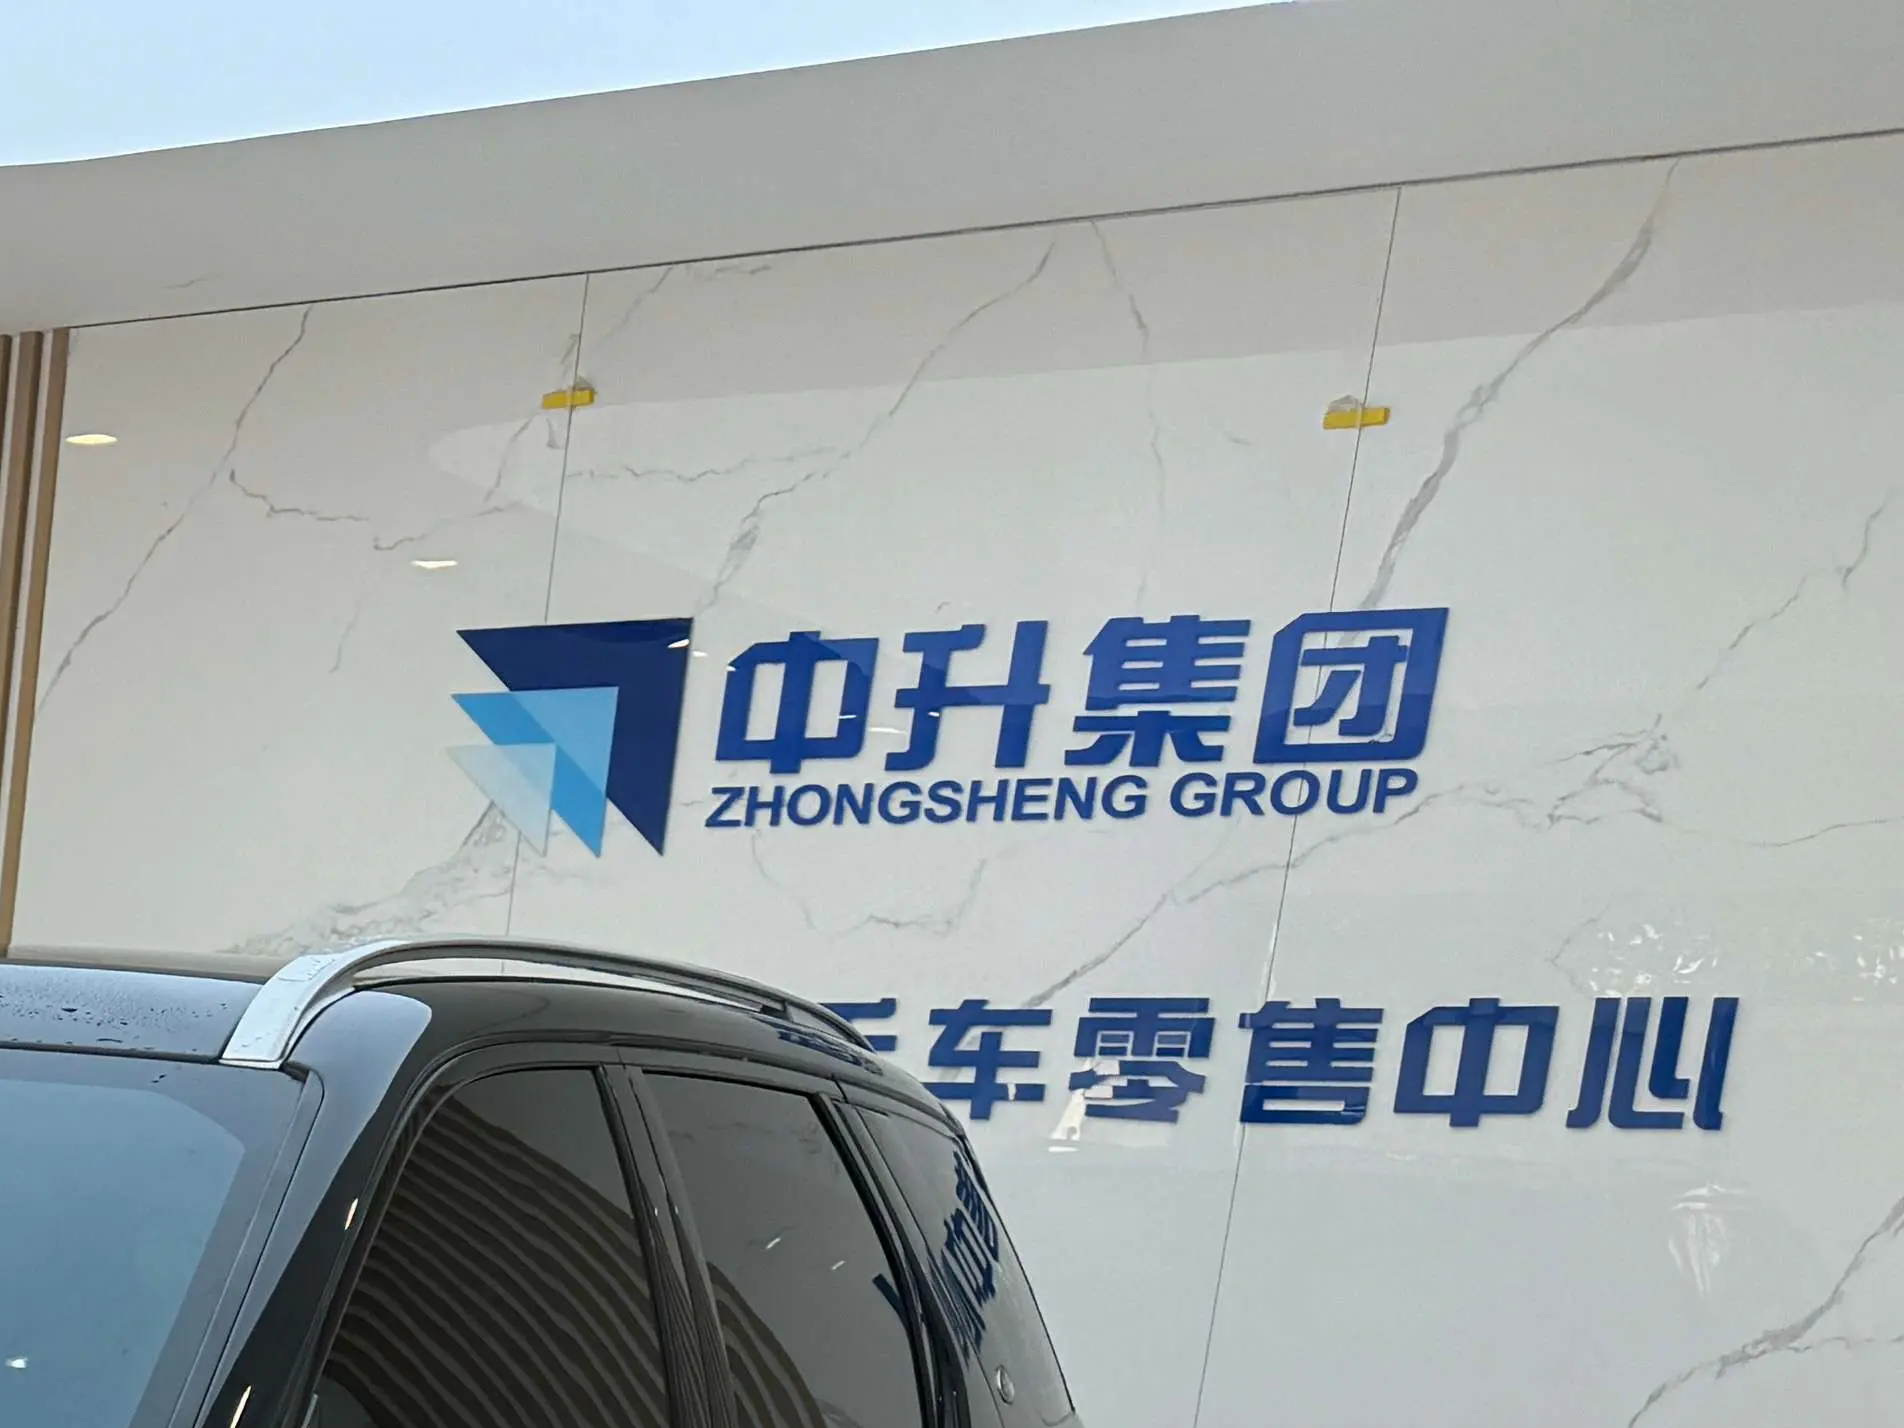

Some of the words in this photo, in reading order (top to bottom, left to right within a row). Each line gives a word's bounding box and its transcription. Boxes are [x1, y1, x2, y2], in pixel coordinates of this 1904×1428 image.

[714, 606, 1450, 776] 中升集团
[705, 775, 1149, 829] ZHONGSHENG
[1168, 767, 1420, 819] GROUP
